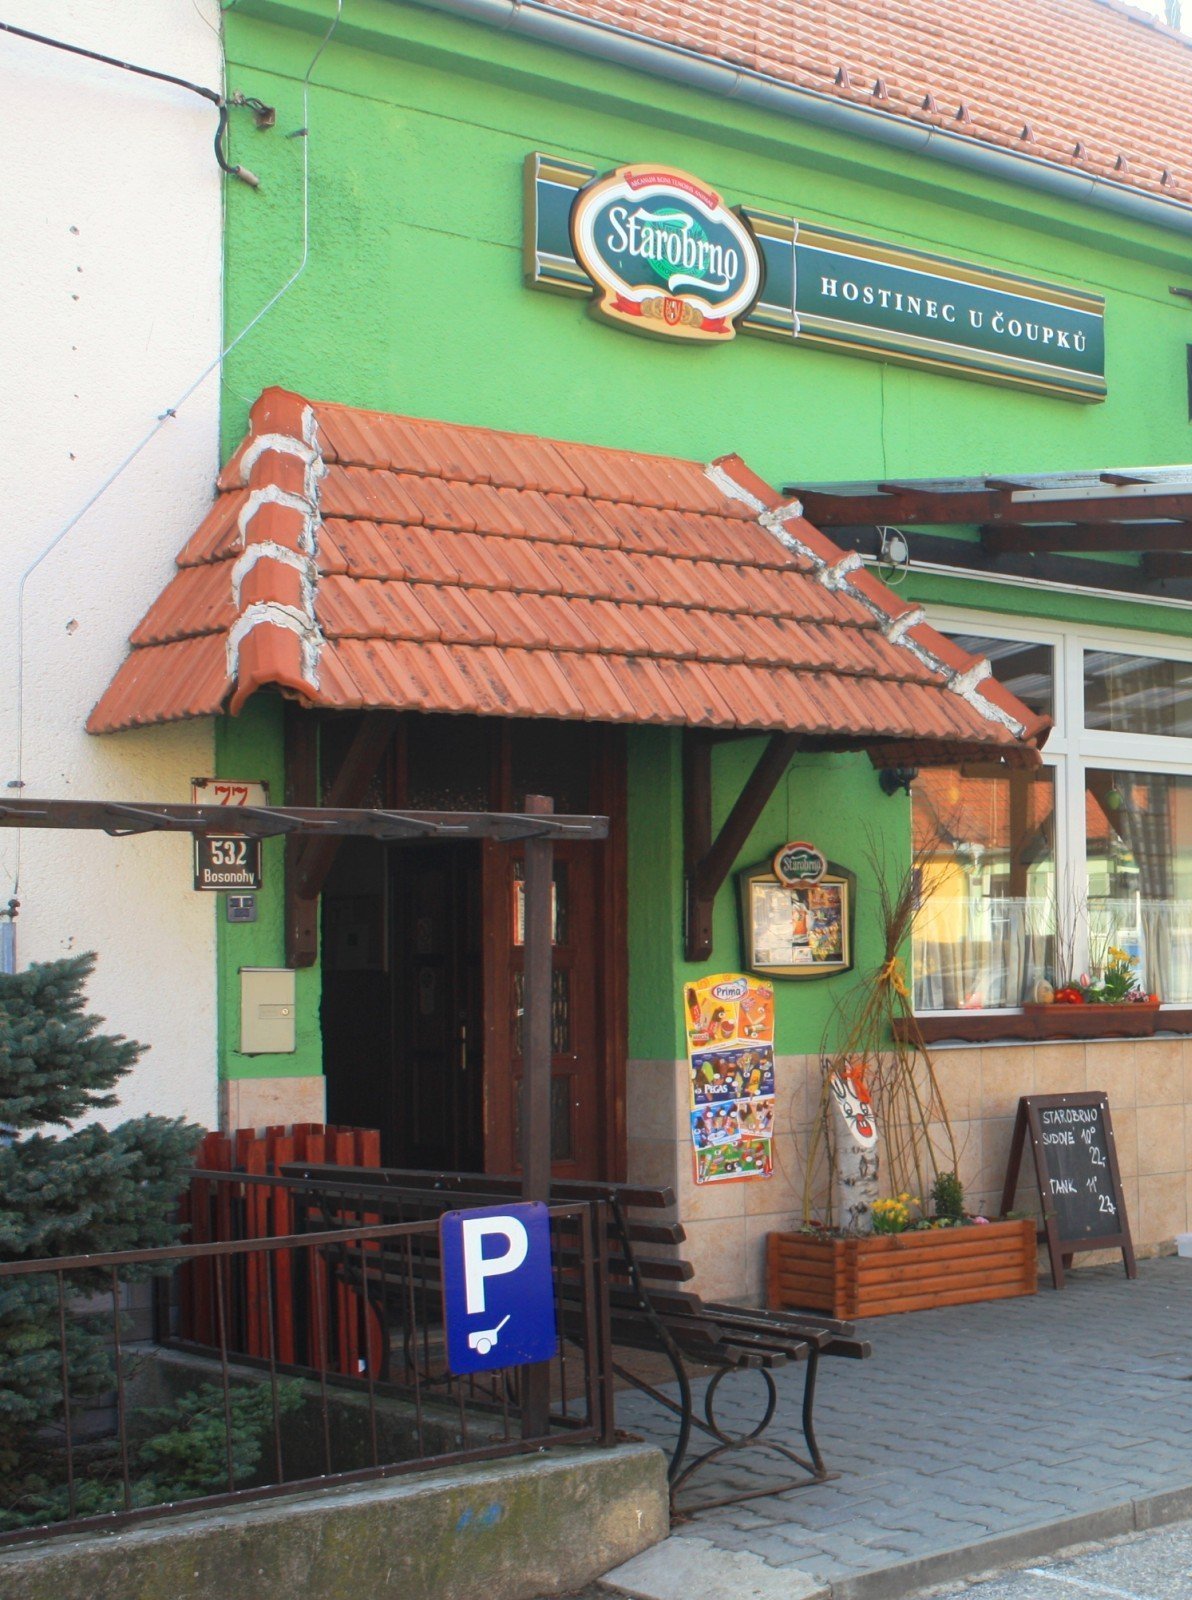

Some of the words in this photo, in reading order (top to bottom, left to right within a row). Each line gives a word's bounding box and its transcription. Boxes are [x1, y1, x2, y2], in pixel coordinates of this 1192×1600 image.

[607, 207, 738, 291] Starobrno
[821, 277, 956, 323] HOSTINEC
[968, 309, 984, 329] U
[991, 311, 1087, 352] ČOUPKŮ
[215, 786, 248, 805] 77
[211, 841, 247, 865] 532
[783, 855, 823, 877] Starobrno
[204, 869, 255, 885] Bosonohy
[716, 987, 741, 997] Prima
[705, 1084, 728, 1094] PEGAS
[1043, 1108, 1098, 1124] STAROBRNO
[1049, 1178, 1078, 1194] TANK
[462, 1215, 528, 1315] P
